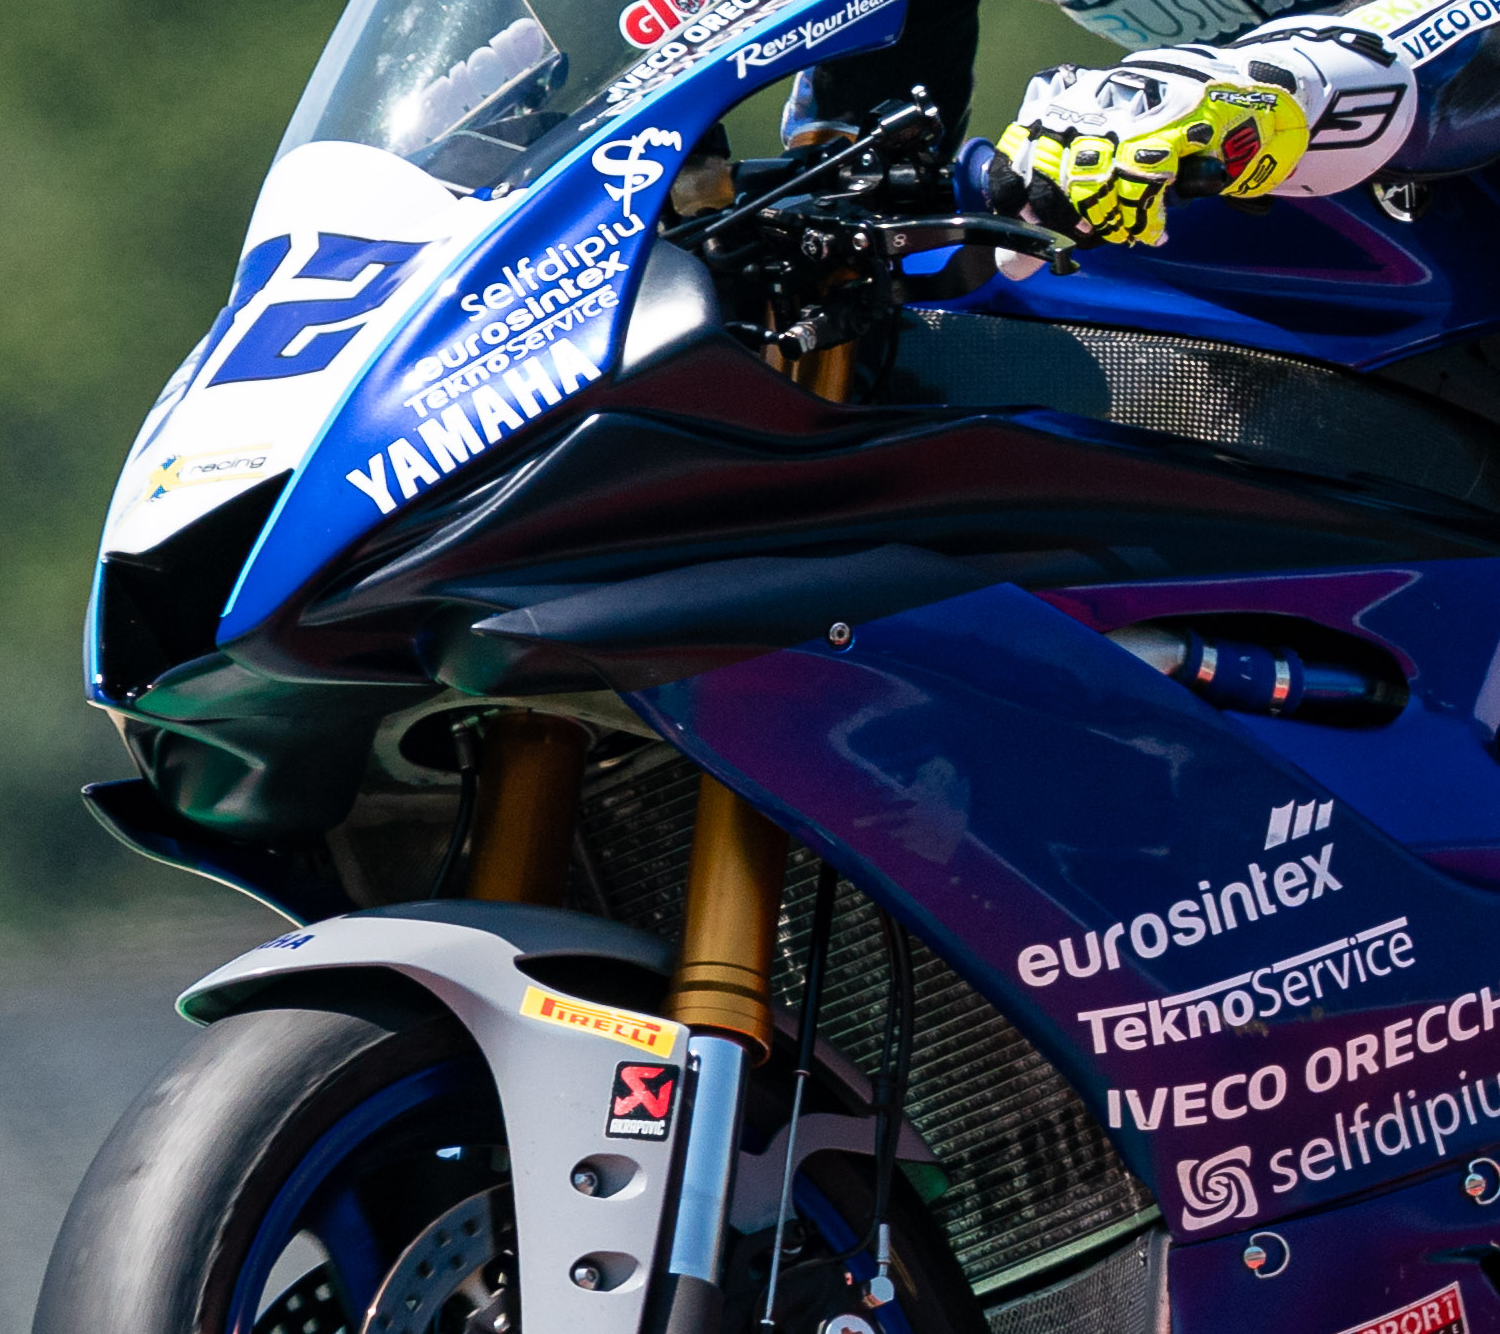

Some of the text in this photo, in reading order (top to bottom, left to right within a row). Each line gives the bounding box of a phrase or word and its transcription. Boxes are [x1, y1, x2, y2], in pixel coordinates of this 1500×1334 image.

[726, 26, 799, 80] Revs
[796, 8, 846, 50] Your
[1401, 10, 1471, 60] VECO
[408, 250, 630, 383] eurosintex
[346, 338, 603, 515] YAMAHA
[1017, 842, 1343, 988] eurosintex
[540, 997, 662, 1047] PIRELLI
[1078, 916, 1416, 1055] TeknoService
[1107, 1065, 1288, 1131] IVECO
